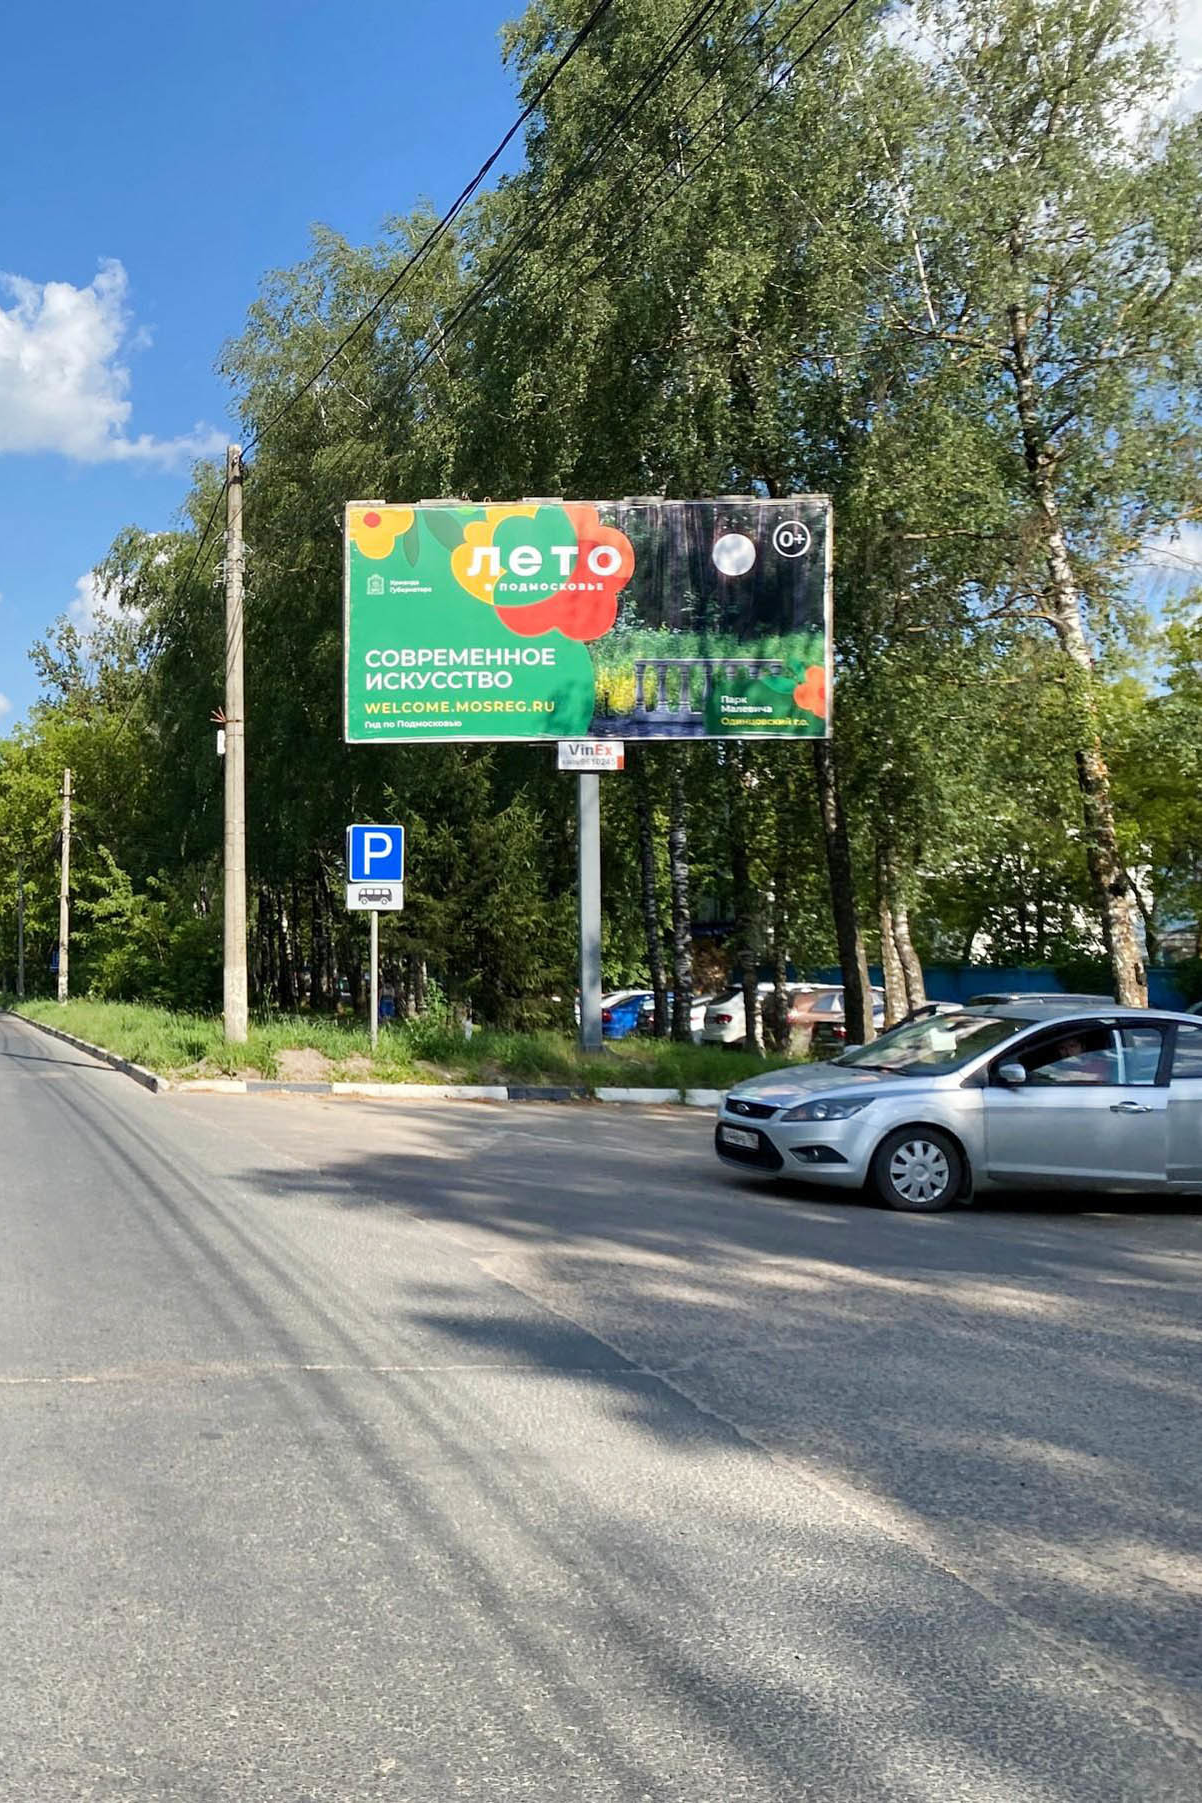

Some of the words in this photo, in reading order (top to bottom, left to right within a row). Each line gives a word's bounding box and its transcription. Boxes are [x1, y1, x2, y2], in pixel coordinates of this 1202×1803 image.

[779, 531, 806, 547] 0+
[365, 648, 555, 667] СОВРЕМЕННОЕ
[365, 671, 513, 690] ИСКУССТВО
[721, 696, 747, 704] Парк
[365, 701, 555, 714] WELCOME.MOSREG.RU
[365, 721, 381, 729] Гид
[569, 744, 613, 755] VinEx
[364, 832, 393, 875] P
